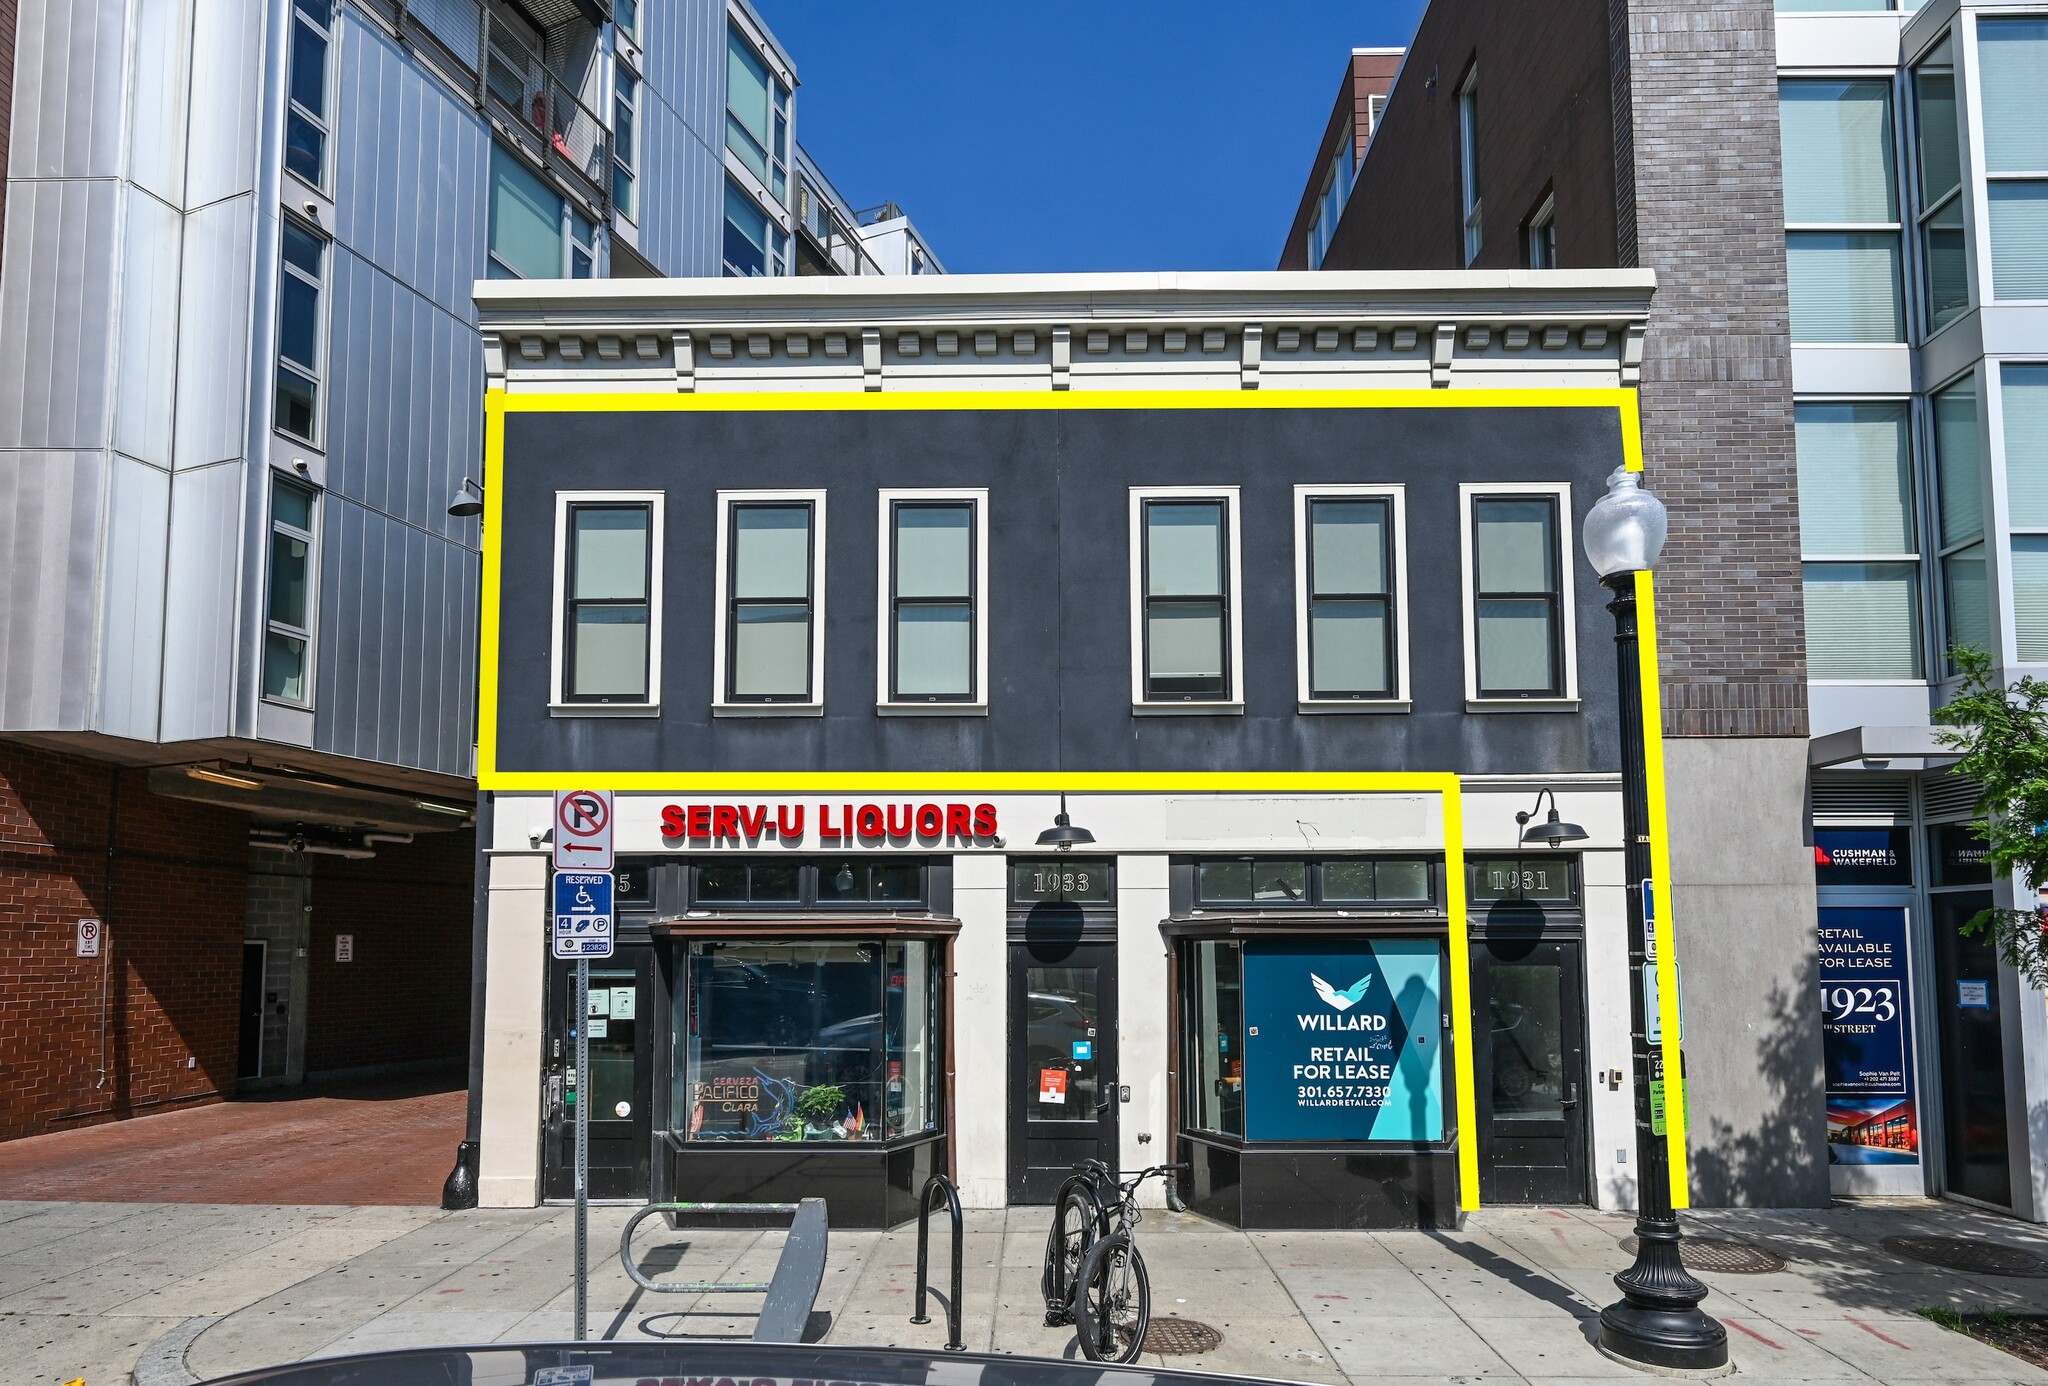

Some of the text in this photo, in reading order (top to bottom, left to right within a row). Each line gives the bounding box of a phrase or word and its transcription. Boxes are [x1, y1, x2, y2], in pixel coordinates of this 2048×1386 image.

[660, 804, 998, 838] SERV-U LIQUORS
[1832, 849, 1896, 858] CUSHMAN &
[1832, 858, 1897, 866] WAKEFIELD
[566, 875, 603, 885] RESERVED
[1033, 873, 1089, 892] 1933
[1493, 870, 1549, 890] 1931
[560, 918, 569, 929] 4
[1817, 929, 1864, 939] RETAIL
[1818, 943, 1892, 953] AVAILABLE
[1848, 958, 1893, 968] LEASE
[1820, 988, 1895, 1021] 1923
[1297, 1015, 1386, 1031] WILLARD
[1834, 1024, 1876, 1034] STREET
[1311, 1047, 1374, 1062] RETAIL
[1293, 1065, 1390, 1079] FOR LEASE
[713, 1077, 759, 1086] CERVEZA
[692, 1081, 759, 1101] PACIFICO
[1298, 1086, 1391, 1098] 301.657.7330
[722, 1102, 758, 1112] CLARA
[1298, 1099, 1392, 1107] WILLARDRETAIL.COM
